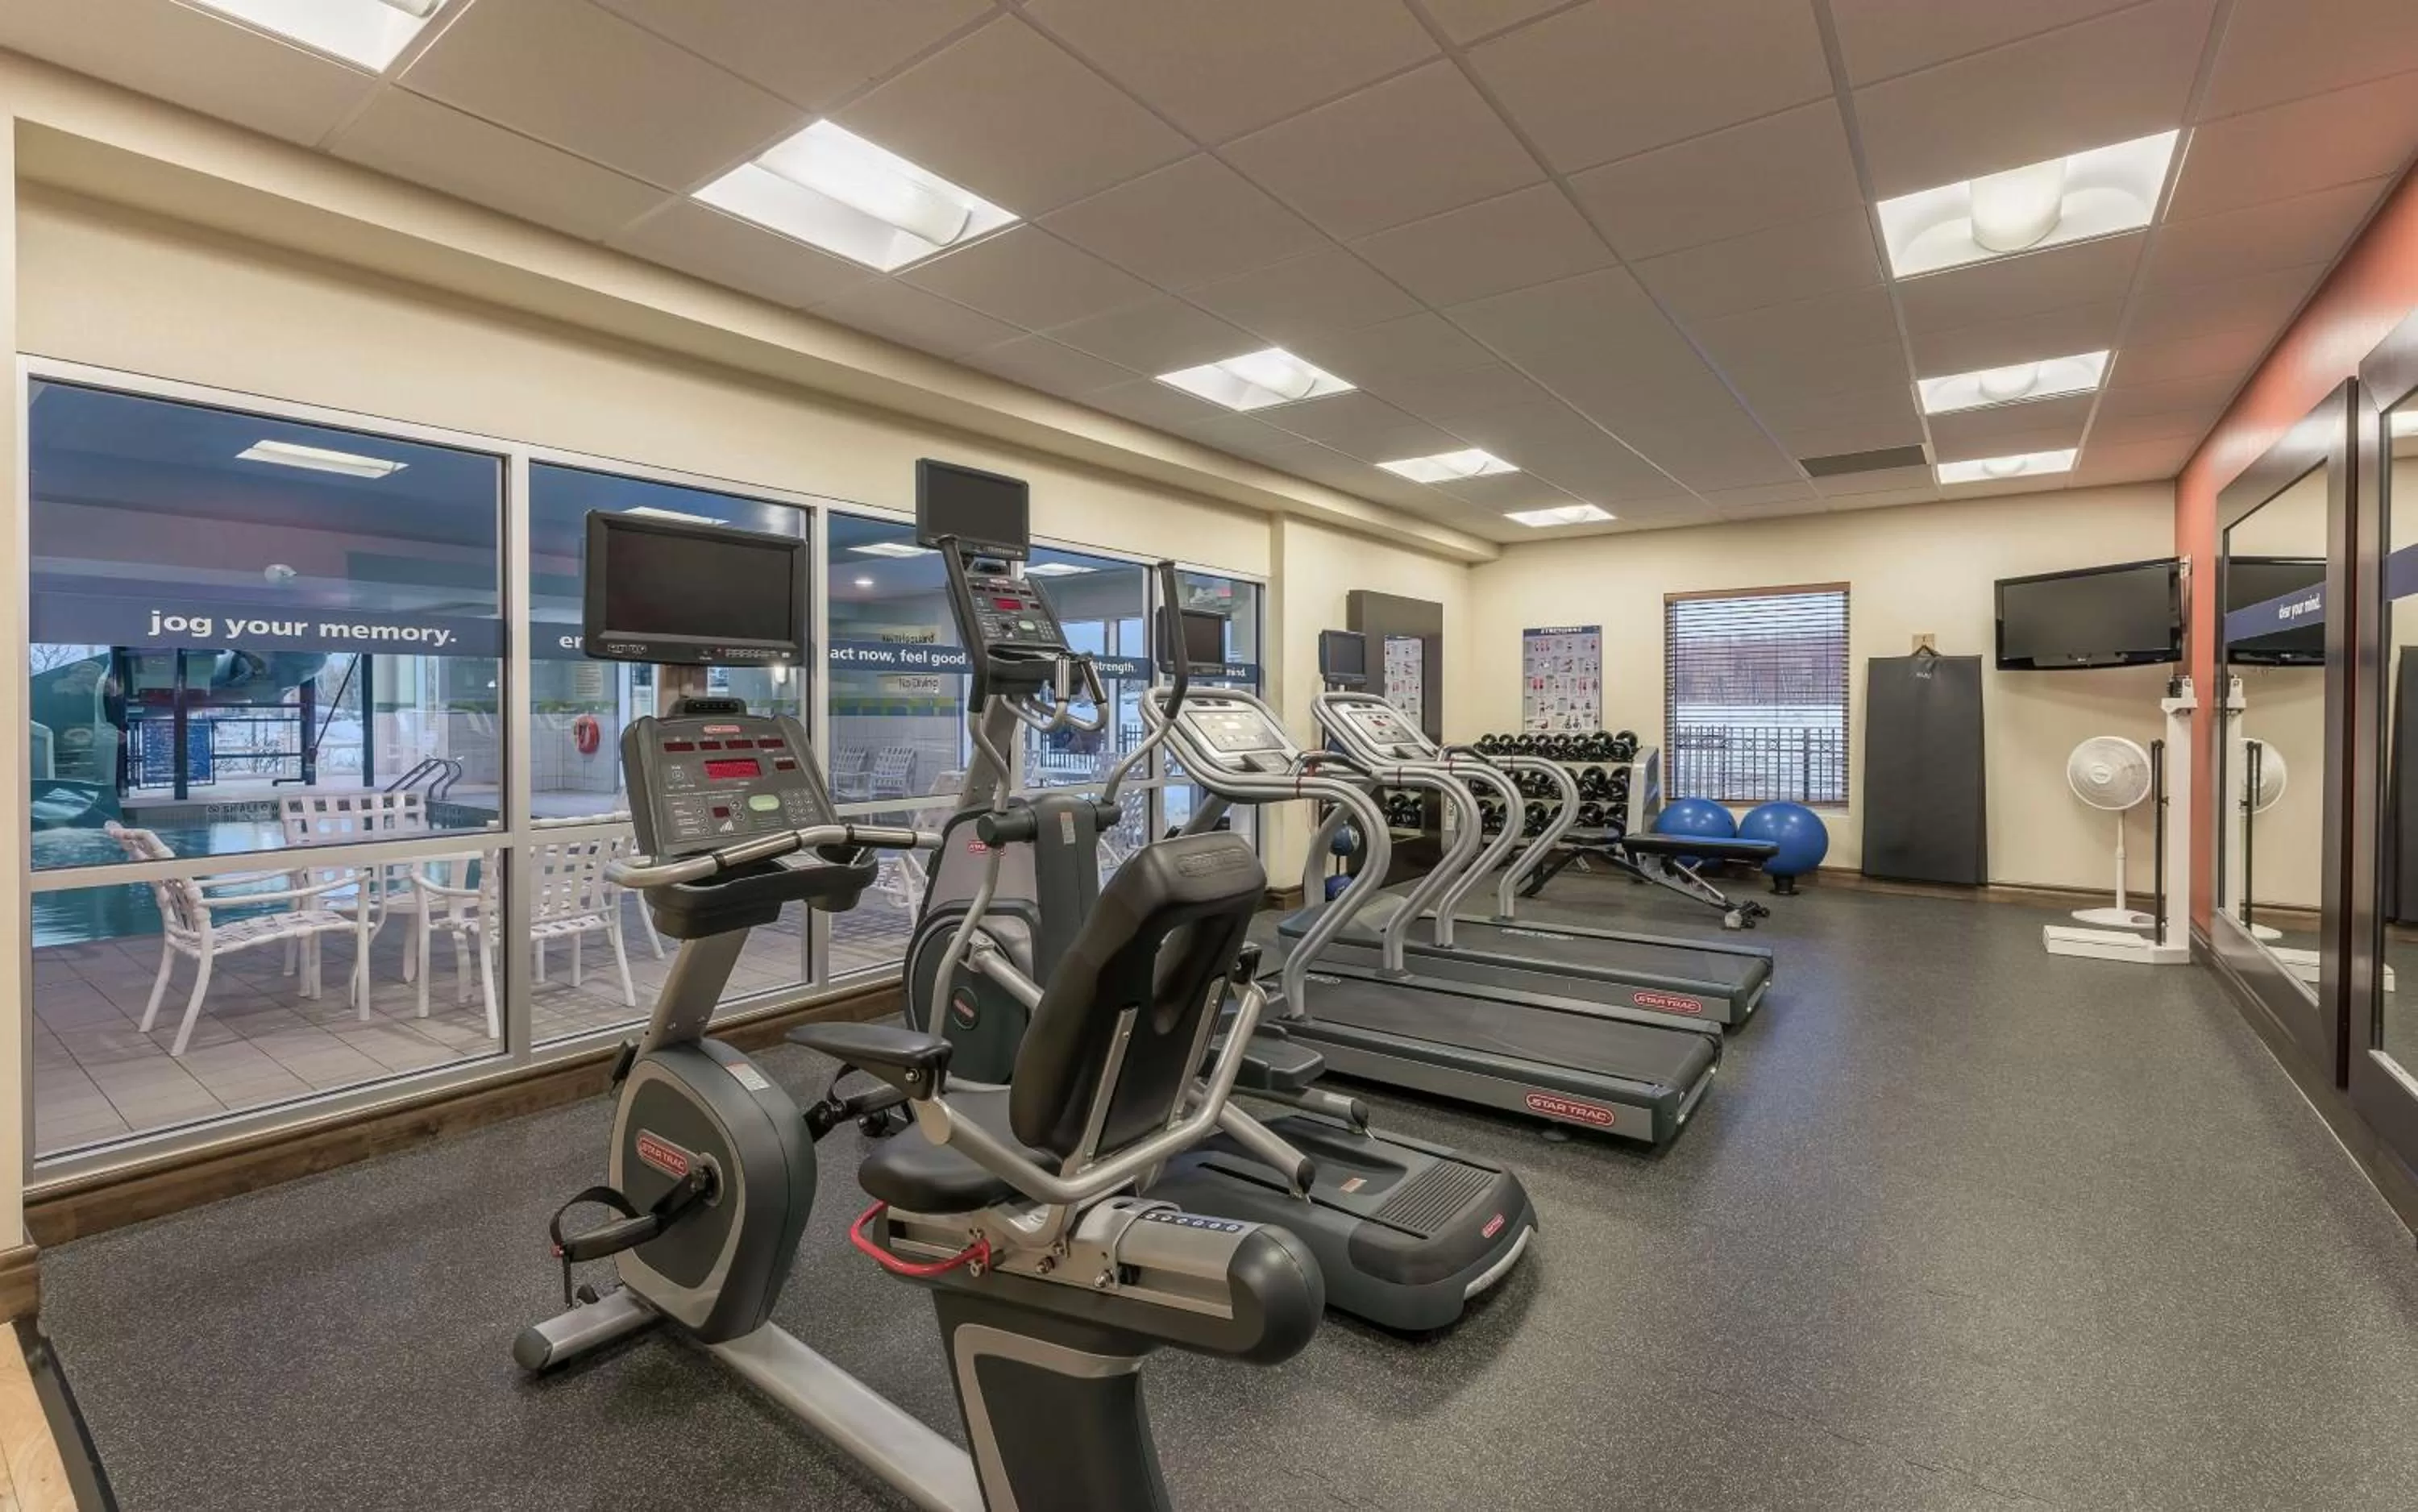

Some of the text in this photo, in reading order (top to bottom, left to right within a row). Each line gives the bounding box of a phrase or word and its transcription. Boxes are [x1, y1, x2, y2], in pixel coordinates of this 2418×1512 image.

[147, 610, 458, 646] jog your memory.
[829, 648, 855, 660] act
[858, 650, 895, 663] now,
[899, 649, 928, 663] feel
[1532, 1098, 1608, 1121] STAR TRAC
